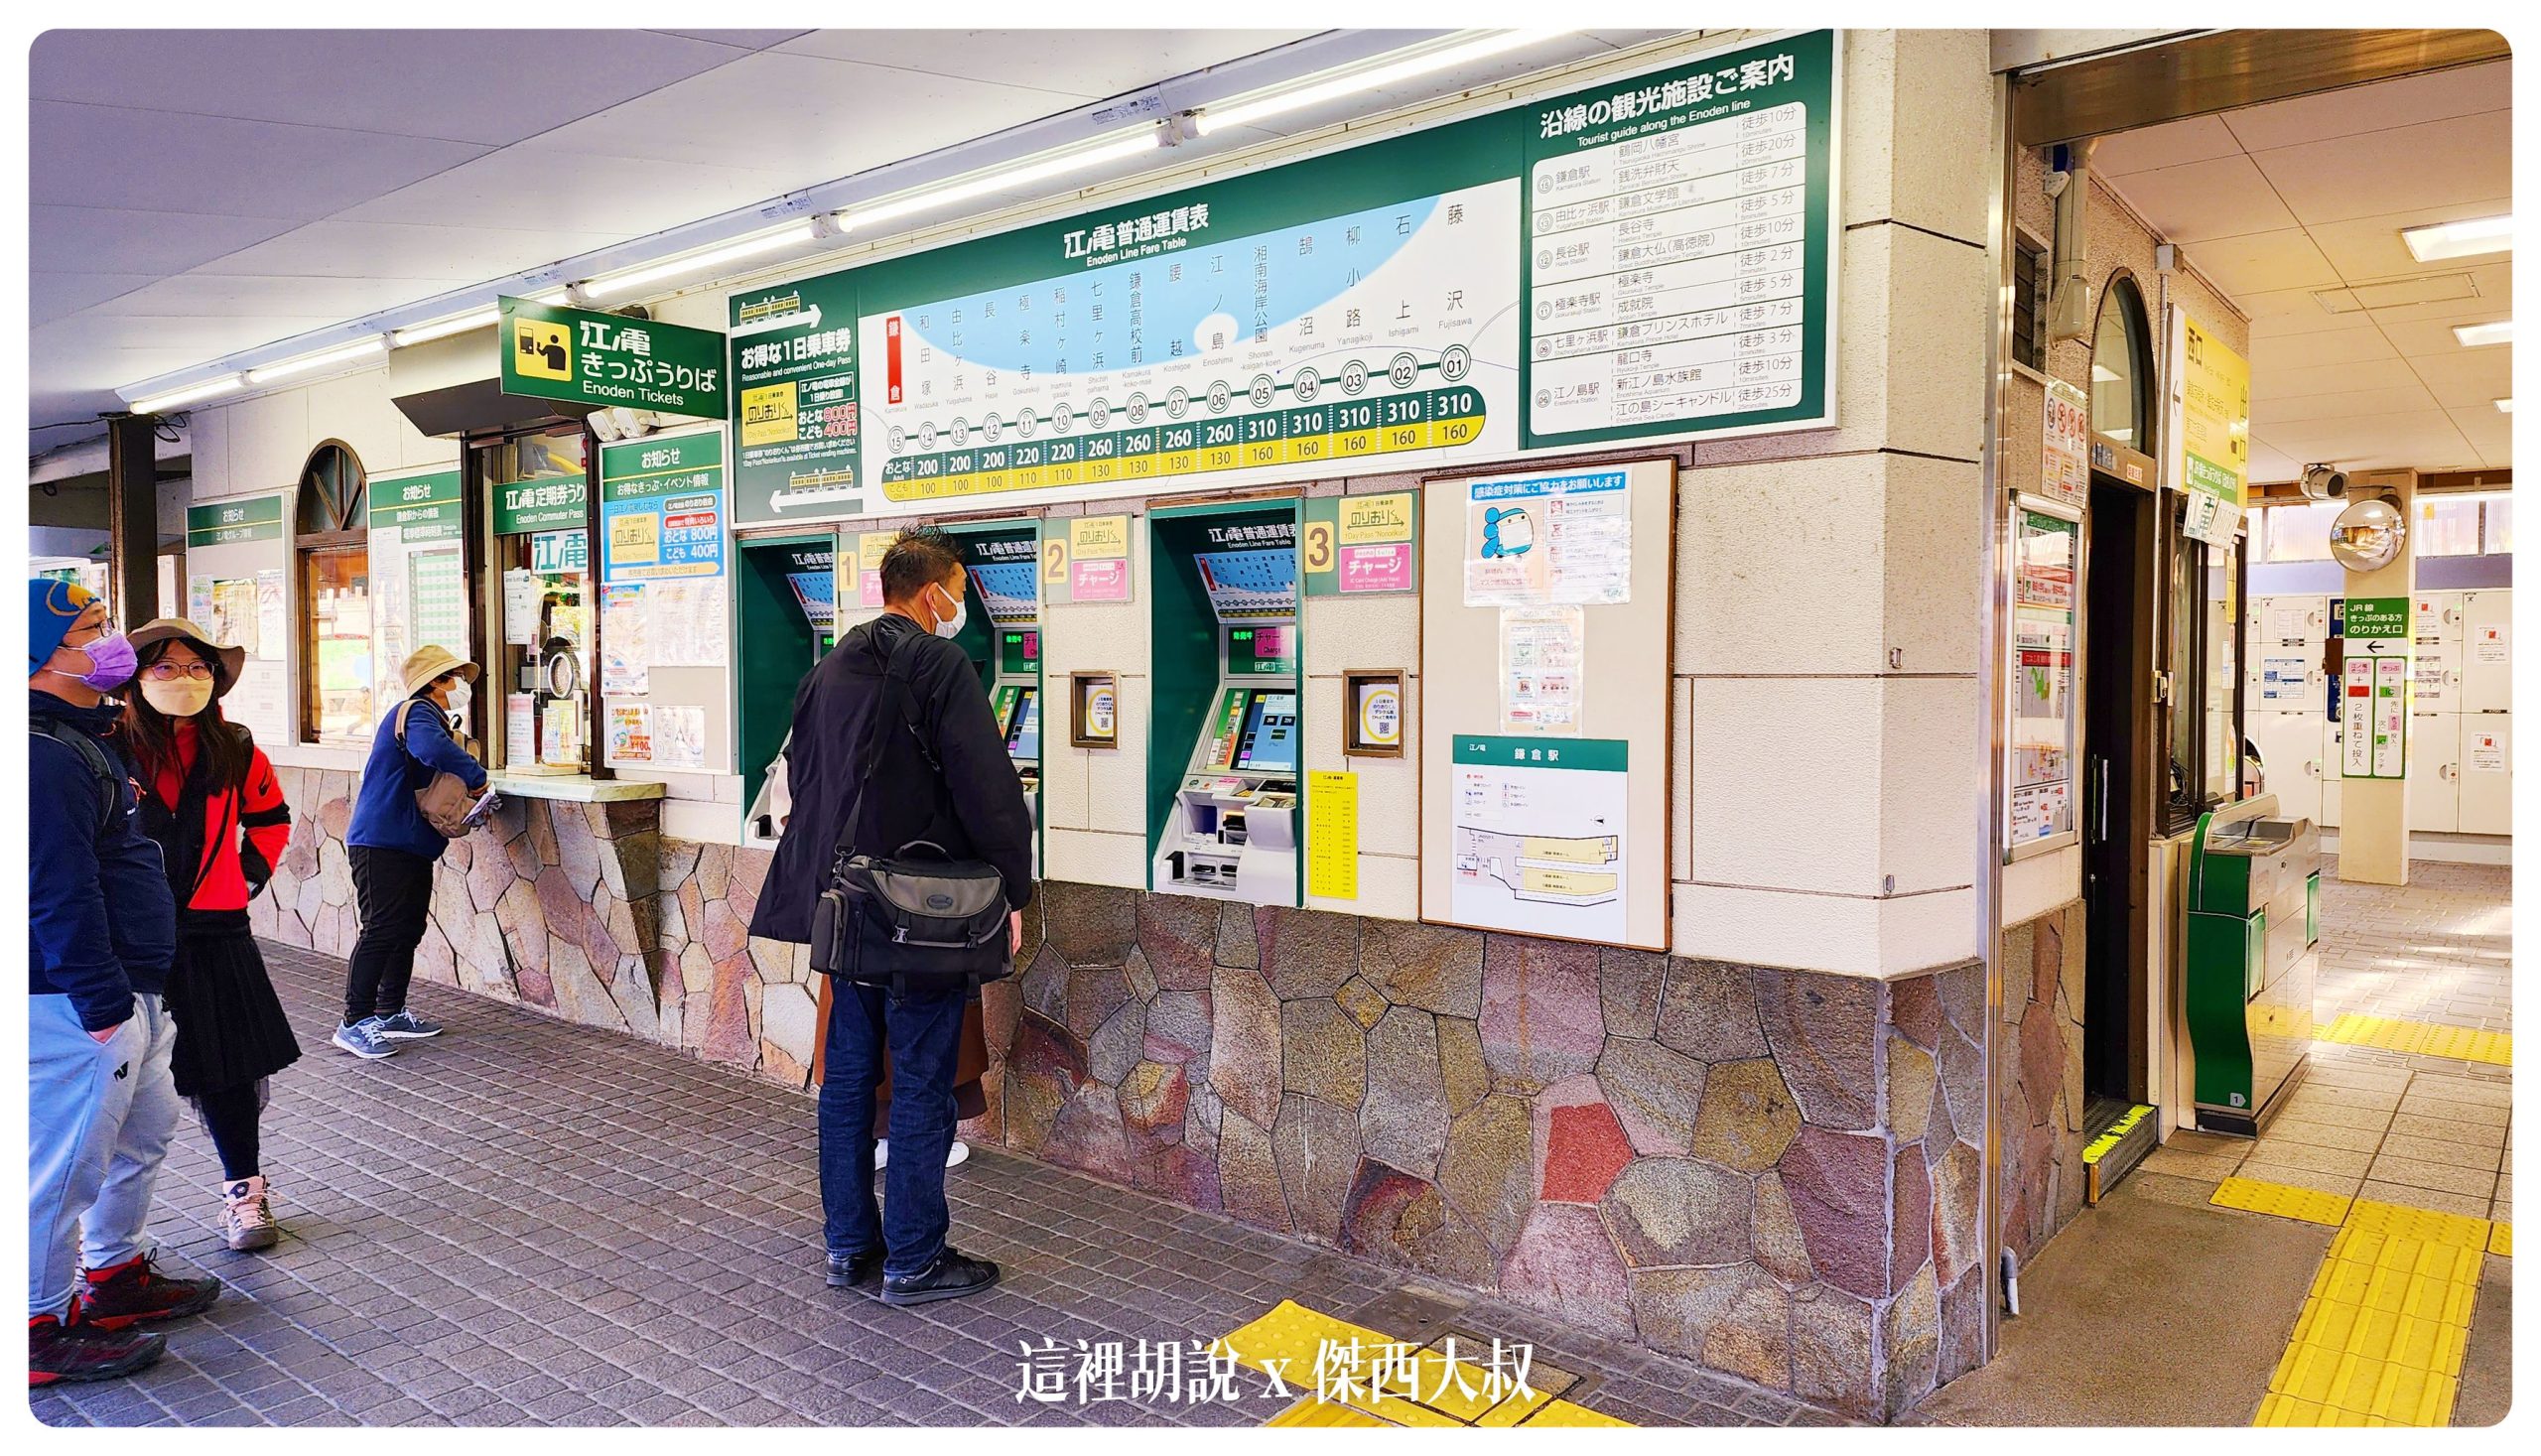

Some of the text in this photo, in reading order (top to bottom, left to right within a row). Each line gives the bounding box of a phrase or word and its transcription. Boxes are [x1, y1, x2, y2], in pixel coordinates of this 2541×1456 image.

[1539, 54, 1794, 139] 沿線の観光施設ご案内
[1577, 98, 1751, 147] Tourist guide along the Enoden line
[1742, 106, 1797, 130] 徒歩10分
[1619, 133, 1679, 159] 鶴岡八幡宮
[1742, 133, 1797, 158] 徒歩20分
[1555, 165, 1590, 184] 鎌倉駅
[1619, 159, 1679, 184] 銭洗弁財天
[1619, 187, 1679, 210] 鎌倉文学館
[1618, 218, 1655, 236] 長谷寺
[1740, 216, 1795, 239] 徒歩10分
[1086, 237, 1187, 267] Enoden Line Fare Table
[1446, 202, 1464, 312] 藤沢
[1555, 241, 1590, 260] 長谷駅
[1346, 225, 1362, 329] 柳小路
[1396, 214, 1412, 320] 石上
[1298, 236, 1314, 336] 鵠沼
[1618, 271, 1654, 288] 極楽寺
[1210, 254, 1225, 350] 江ノ島
[1254, 245, 1269, 344] 湘南海岸公園
[1554, 292, 1601, 311] 極楽寺駅
[1169, 263, 1182, 358] 腰越
[1618, 297, 1654, 314] 成就院
[1129, 271, 1142, 364] 鎌倉高校前
[1438, 317, 1473, 330] Fujisawa
[1617, 312, 1728, 339] 鎌倉プリンスホテル
[580, 320, 650, 357] 江ノ電
[1018, 294, 1031, 381] 極楽寺
[1336, 332, 1373, 347] Yanagikoji
[1389, 325, 1419, 337] Ishigami
[741, 328, 851, 369] お得な1日乗車券
[985, 301, 997, 386] 長谷
[1288, 340, 1325, 354] Kugenuma
[888, 320, 901, 401] 鎌倉
[919, 314, 931, 396] 和田塚
[1203, 355, 1234, 367] Enoshima
[1249, 349, 1273, 360] Shonan
[1617, 349, 1653, 366] 龍口寺
[581, 352, 718, 393] きっぷうりば
[742, 356, 852, 382] Reasonable and convenient One-day Pass
[1395, 366, 1411, 380] 02
[1446, 358, 1463, 373] 01
[1739, 355, 1793, 375] 徒歩10分
[1299, 381, 1314, 394] 04
[1346, 374, 1362, 387] 03
[1617, 368, 1702, 391] 新江ノ島水族館
[583, 380, 684, 406] Enoden Tickets
[1212, 393, 1226, 405] 06
[1255, 387, 1269, 400] 05
[1554, 382, 1600, 400] 江ノ島駅
[1738, 383, 1793, 402] 徒歩25分
[1132, 405, 1143, 417] 08
[1170, 399, 1183, 411] 07
[1616, 391, 1731, 416] 江の島シーキャンドル
[798, 402, 858, 426] おとな 800円
[1057, 415, 1068, 426] 10
[1094, 410, 1106, 422] 09
[799, 425, 823, 440] こども
[824, 419, 858, 438] 400円
[885, 392, 1472, 475] おとな 200 200 200 220 220 260 260 260 260 310 310 310 310 310
[954, 430, 965, 440] 13
[988, 425, 998, 435] 12
[1021, 420, 1031, 431] 11
[641, 449, 681, 469] お知らせ
[921, 482, 936, 494] 100
[953, 478, 969, 491] 100
[987, 475, 1003, 487] 100
[1020, 471, 1036, 484] 110
[1054, 467, 1072, 481] 110
[1092, 464, 1110, 477] 130
[1130, 461, 1147, 474] 130
[1169, 456, 1189, 470] 130
[1211, 451, 1231, 465] 130
[1252, 446, 1273, 462] 160
[1297, 441, 1319, 457] 160
[1344, 435, 1366, 451] 160
[1392, 429, 1415, 446] 160
[1443, 423, 1467, 440] 160
[402, 483, 432, 501] お知らせ
[506, 483, 588, 510] 江ノ電定期券うり
[1474, 475, 1623, 499] 感染症対策にご協力をお願いします
[222, 507, 244, 523] お知らせ
[516, 508, 584, 524] Enoden Commuter Pass
[664, 526, 718, 544] おとな 800円
[666, 543, 718, 560] こども 400円
[1308, 527, 1330, 567] 3
[1047, 543, 1065, 579] 2
[1348, 557, 1403, 576] チャージ
[842, 556, 851, 587] 1
[1078, 571, 1120, 587] チャージ
[2349, 613, 2403, 622] きっぷのある方
[2349, 624, 2403, 634] のりかえ口
[2352, 703, 2363, 767] 2枚重ねて投入
[1514, 747, 1559, 761] 鎌倉駅
